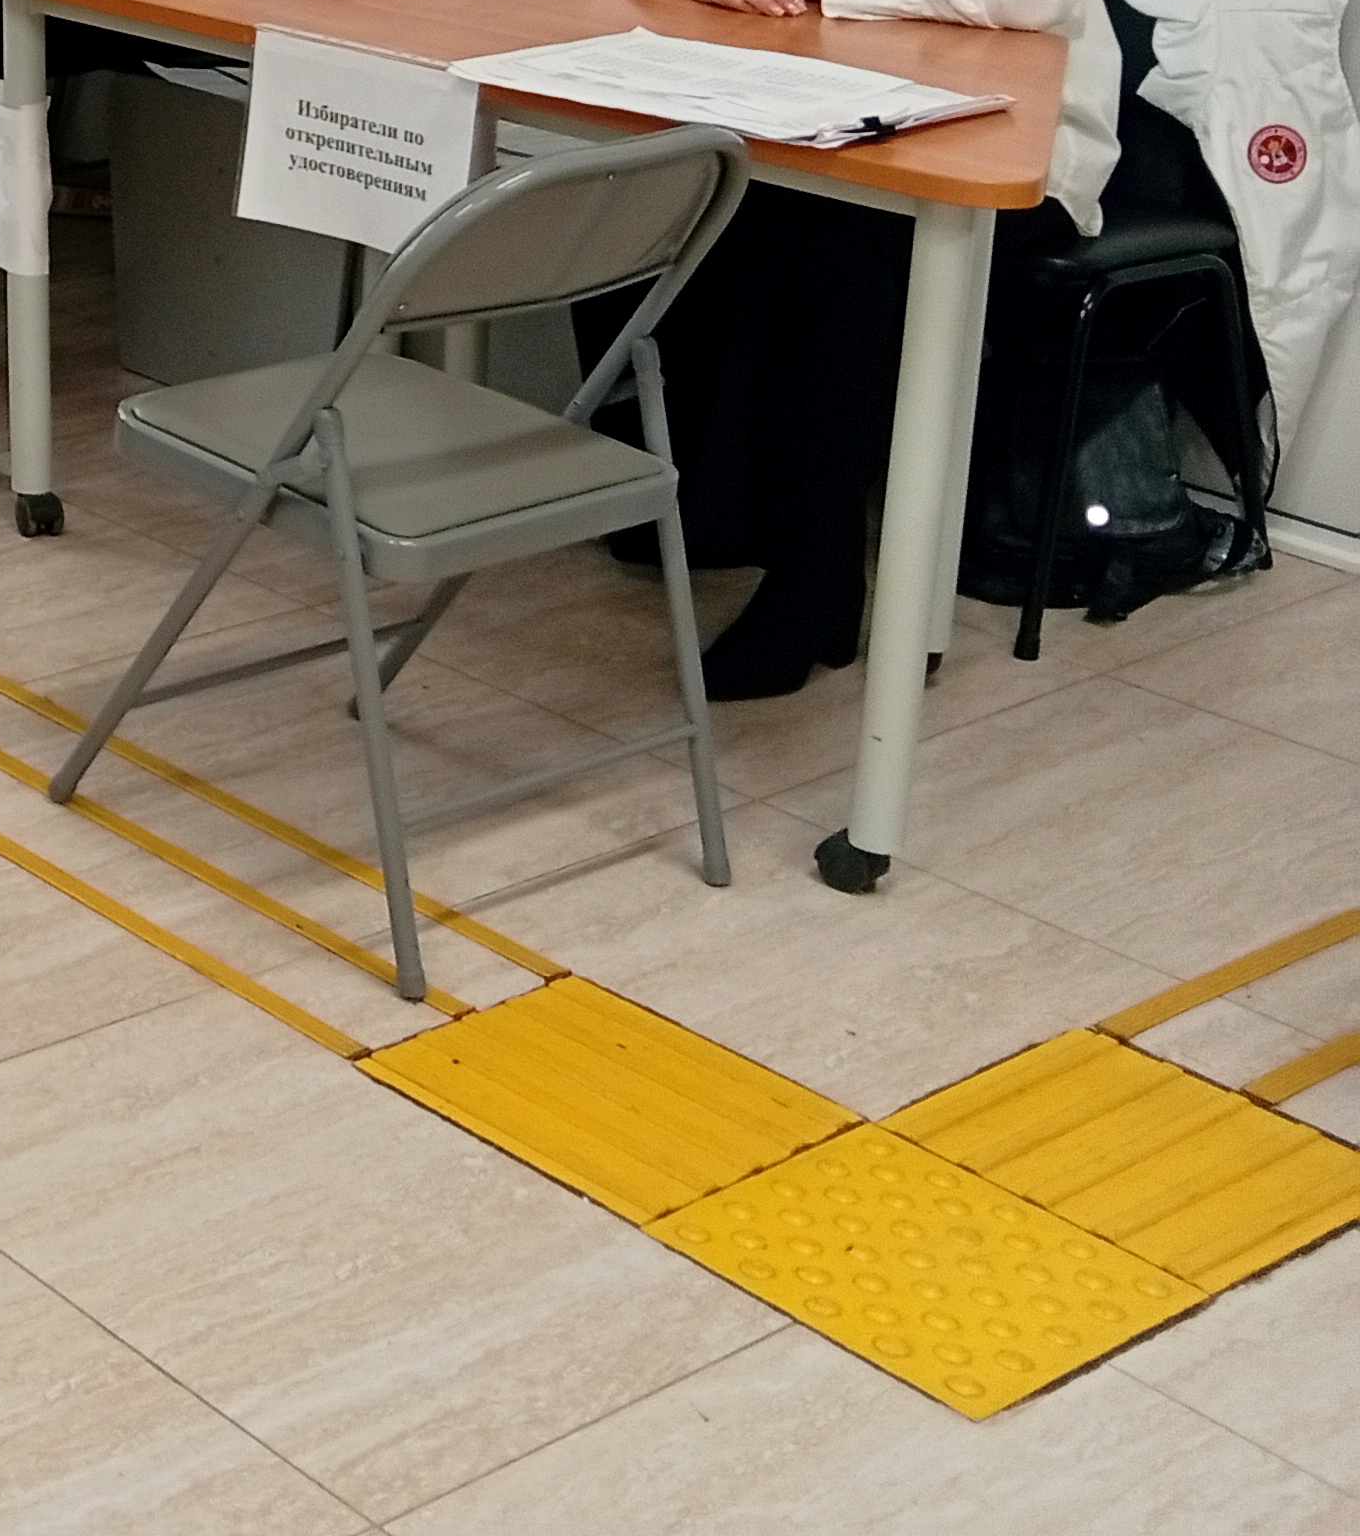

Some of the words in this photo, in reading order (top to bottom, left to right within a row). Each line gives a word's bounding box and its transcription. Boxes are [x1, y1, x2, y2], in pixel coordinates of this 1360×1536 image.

[298, 99, 398, 139] Избиратели
[404, 130, 424, 146] по
[285, 127, 432, 175] открепительным
[288, 154, 426, 201] удостоверениям
